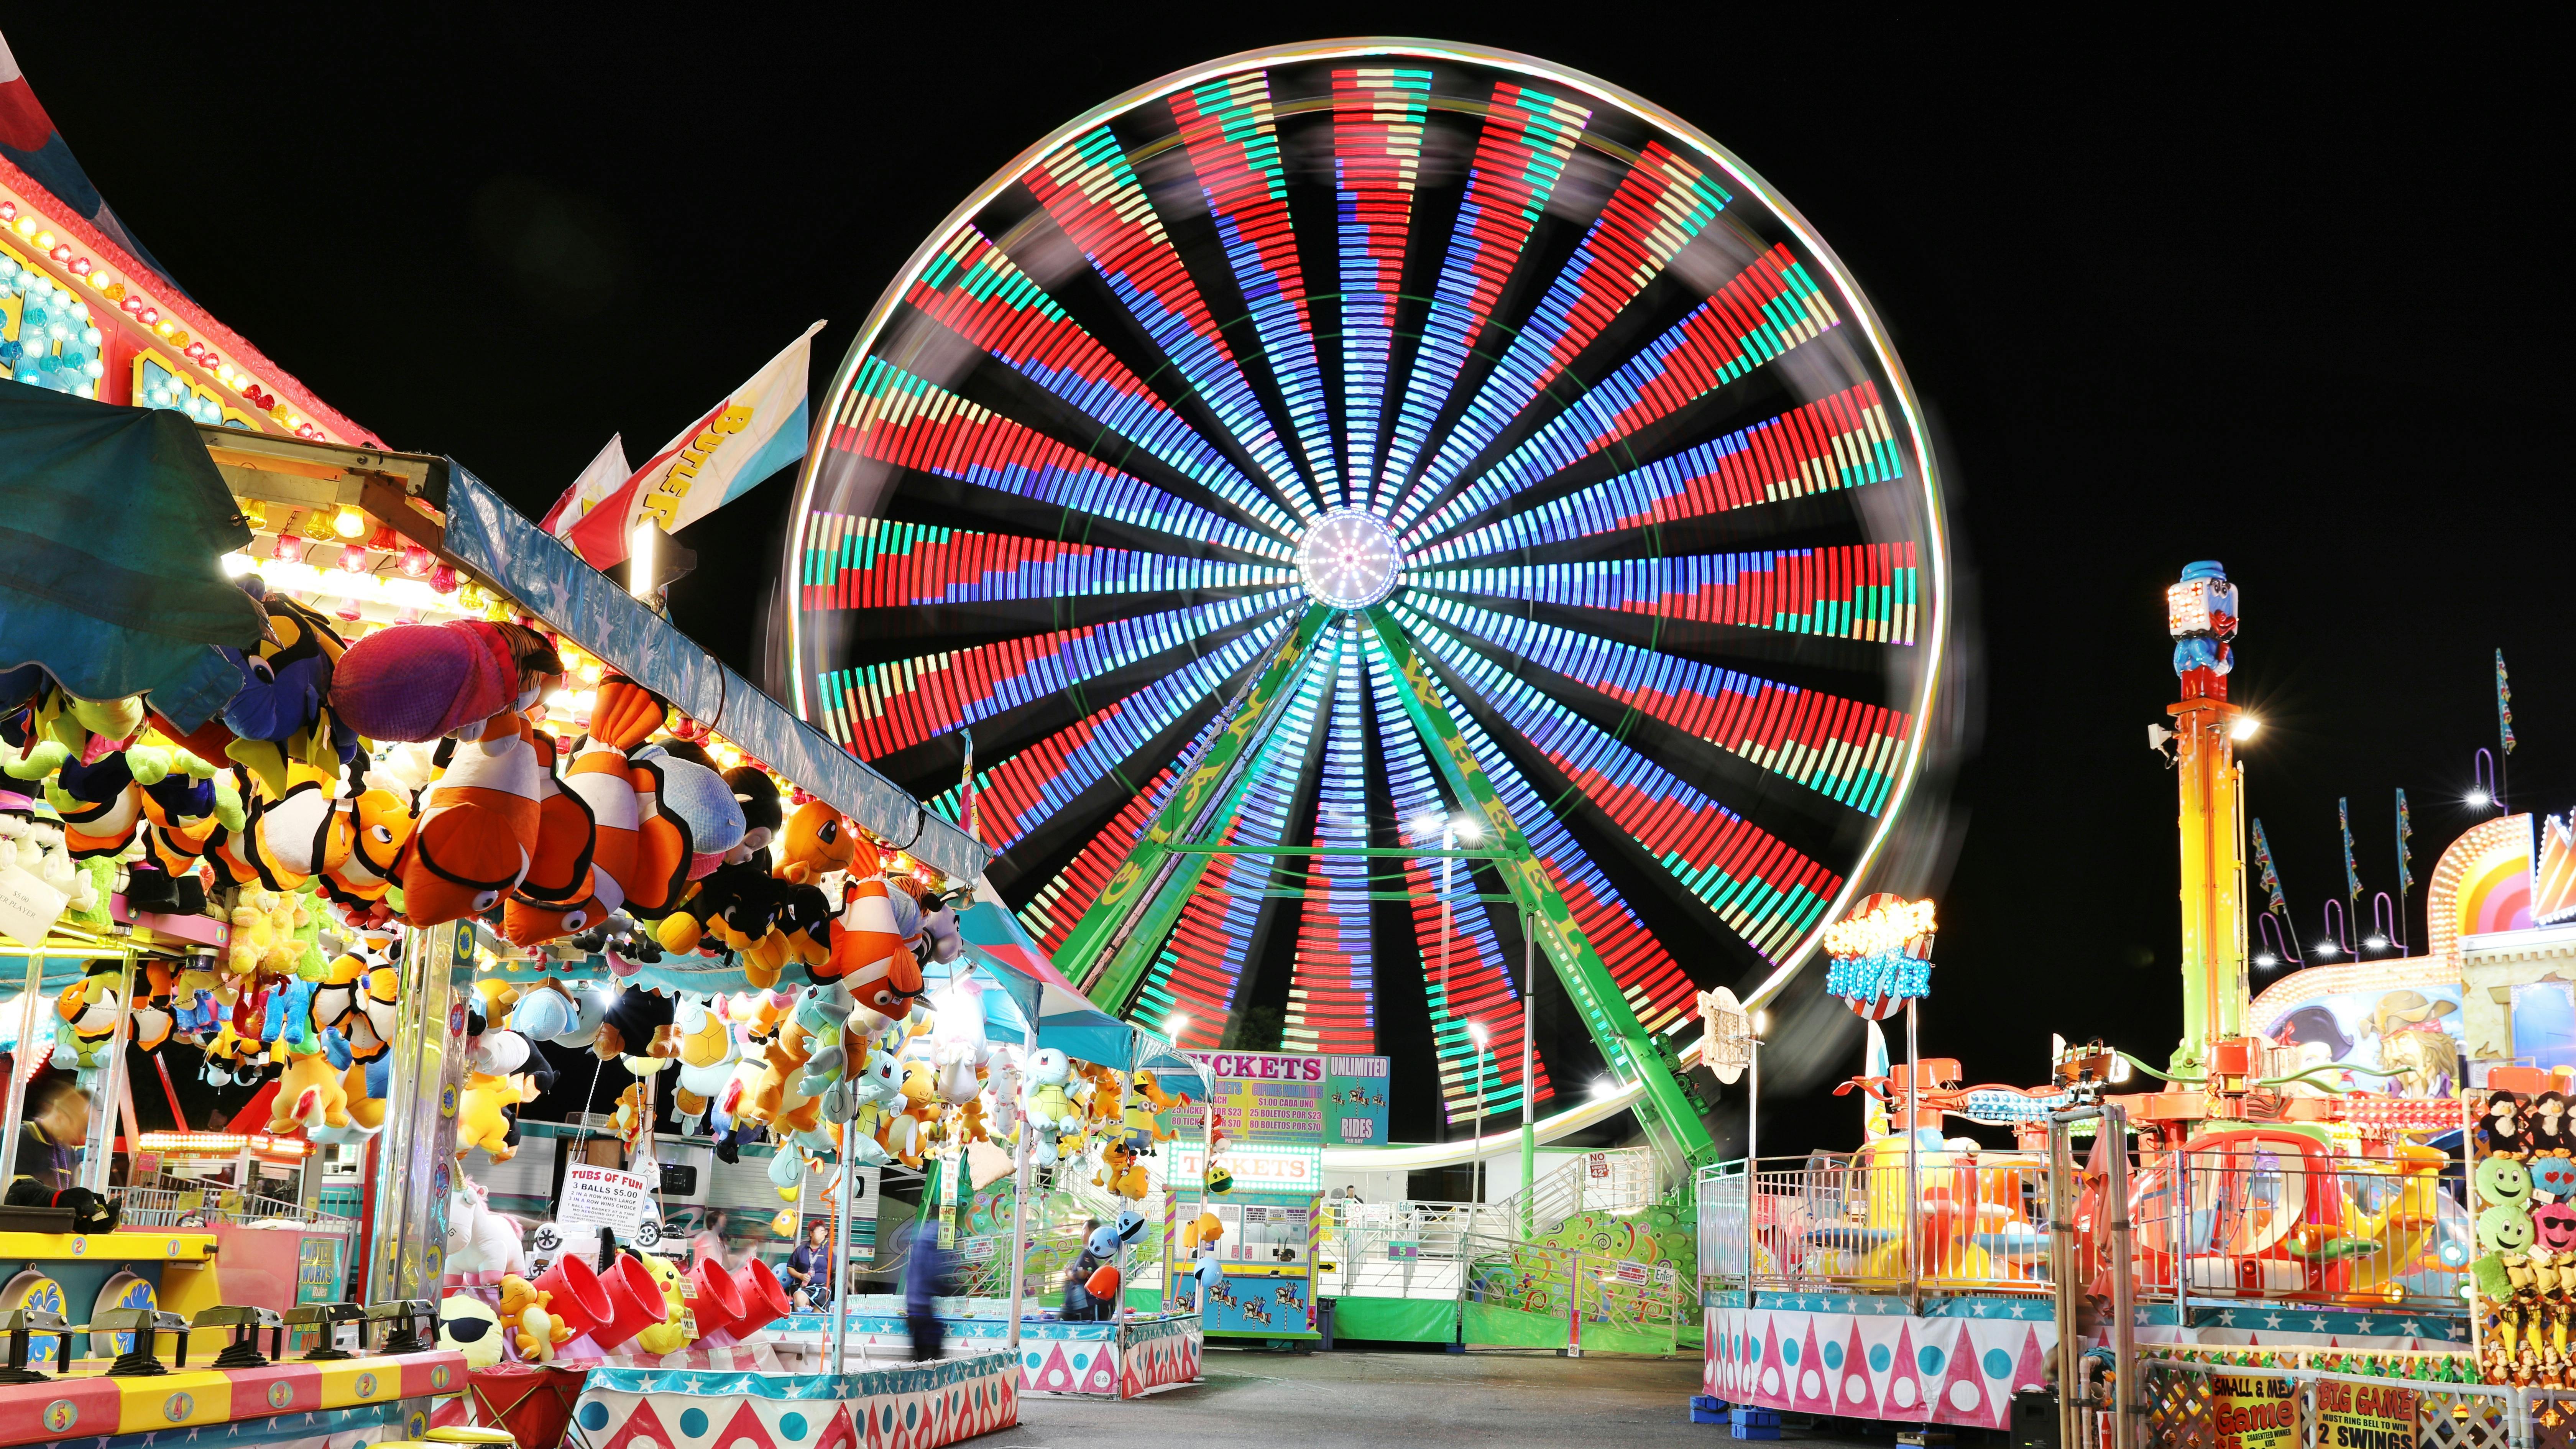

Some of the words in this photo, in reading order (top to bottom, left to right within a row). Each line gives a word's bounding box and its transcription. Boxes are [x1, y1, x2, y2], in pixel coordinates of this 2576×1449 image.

[636, 405, 754, 530] BUTLER
[1101, 627, 1303, 905] GIANT
[1402, 650, 1582, 959] WHEEL
[0, 894, 8, 904] ER
[9, 900, 36, 918] PLAYER
[12, 891, 29, 903] $5.00
[220, 929, 224, 940] 1
[1330, 1056, 1388, 1078] UNLIMITED
[1252, 1083, 1282, 1097] CUPONES
[1283, 1084, 1300, 1097] PARA
[1183, 1106, 1205, 1114] TICKET
[1228, 1107, 1242, 1116] $23
[1258, 1098, 1277, 1107] $1.00
[1279, 1099, 1298, 1107] CADA
[1300, 1100, 1314, 1108] UNO
[1171, 1117, 1181, 1125] 80
[1228, 1119, 1241, 1127] $70
[1250, 1109, 1258, 1117] 25
[1260, 1109, 1290, 1118] BOLETOS
[1292, 1111, 1306, 1119] POR
[1308, 1111, 1321, 1120] $23
[1249, 1120, 1258, 1128] 80
[1260, 1120, 1290, 1130] BOLETOS
[1292, 1122, 1306, 1130] POR
[1308, 1122, 1321, 1131] $70
[1341, 1117, 1373, 1138] RIDES
[1590, 1153, 1605, 1161] NO
[1183, 1156, 1306, 1178] TCKETS
[572, 1171, 601, 1180] TUBS
[604, 1173, 619, 1183] OF
[621, 1176, 643, 1190] FUN
[581, 1183, 611, 1194] BALLS
[614, 1188, 637, 1198] $5.00
[1399, 1201, 1414, 1212] Enter
[75, 1240, 83, 1253] 2
[172, 1242, 176, 1254] 1
[1399, 1247, 1406, 1256] 5
[301, 1263, 333, 1284] WORKS
[1656, 1269, 1673, 1282] Enter
[312, 1286, 327, 1298] Rules
[363, 1376, 370, 1395] 2
[438, 1368, 443, 1387] 1
[276, 1385, 285, 1406] 3
[2214, 1378, 2253, 1397] SMALL
[2256, 1380, 2264, 1398] &
[2267, 1379, 2295, 1398] MED
[174, 1396, 183, 1419] 4
[2318, 1381, 2351, 1413] BIG
[2356, 1387, 2413, 1421] GAME
[54, 1403, 65, 1429] 5
[2216, 1400, 2295, 1436] Game
[2323, 1413, 2342, 1423] MUST
[2344, 1416, 2361, 1426] RING
[2363, 1418, 2379, 1428] BELL
[2381, 1421, 2390, 1429] TO
[2392, 1423, 2408, 1432] WIN
[2247, 1430, 2274, 1442] GUARENTEED
[2274, 1428, 2292, 1438] WINNER
[2265, 1439, 2275, 1447] KIDS
[2318, 1423, 2329, 1444] 2
[2337, 1425, 2412, 1449] SWINGS
